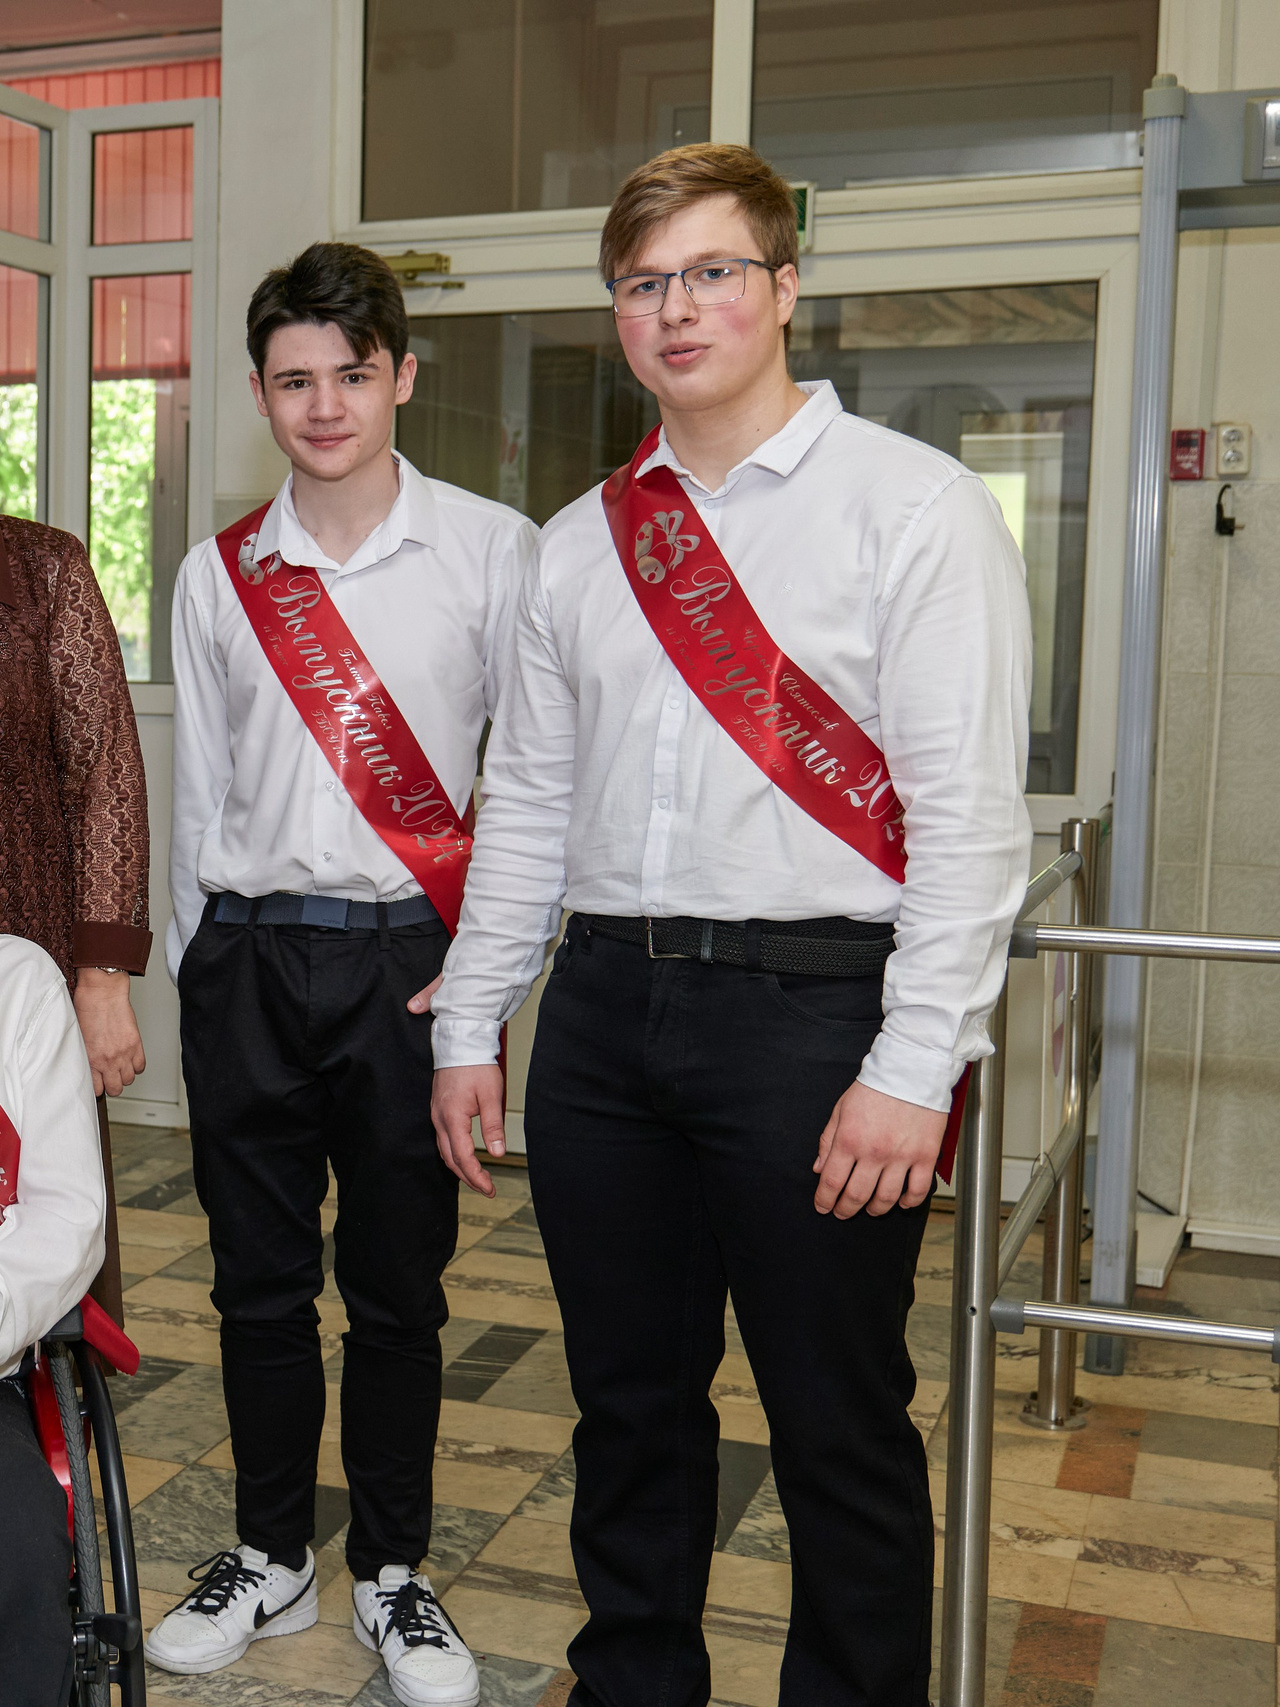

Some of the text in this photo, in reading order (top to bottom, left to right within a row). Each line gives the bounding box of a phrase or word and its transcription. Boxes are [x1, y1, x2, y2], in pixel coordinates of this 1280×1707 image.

[268, 574, 403, 787] Выпускник
[669, 565, 846, 785] Выпускник
[311, 708, 341, 743] ГБОУ
[365, 692, 393, 731] Павел
[778, 672, 840, 732] Святослав
[732, 714, 770, 753] ГБОУ
